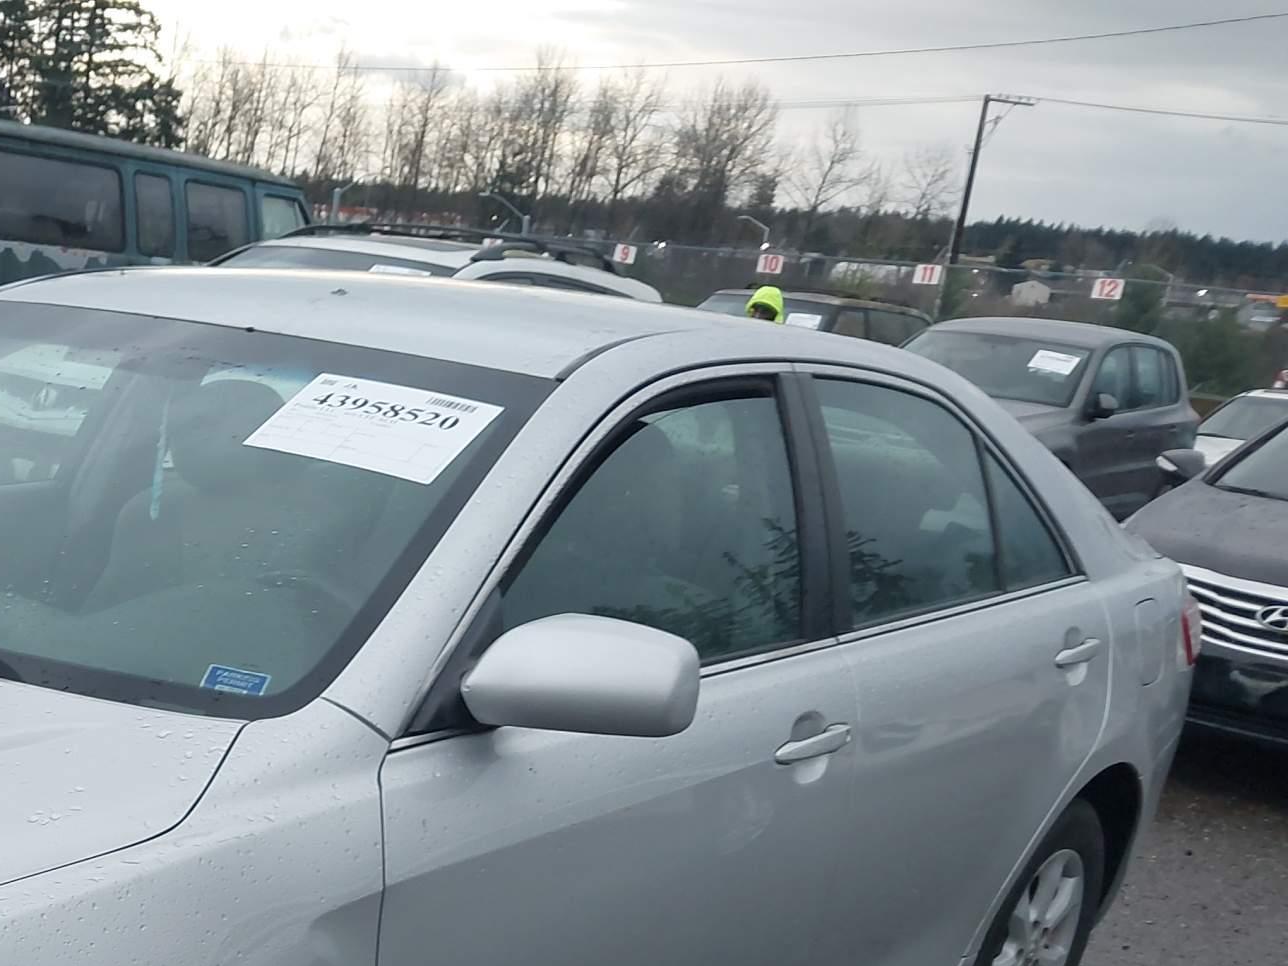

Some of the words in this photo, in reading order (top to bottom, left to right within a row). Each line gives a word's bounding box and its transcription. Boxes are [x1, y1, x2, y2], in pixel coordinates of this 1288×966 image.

[620, 246, 630, 261] 9
[763, 255, 780, 272] 10
[920, 264, 936, 282] 11
[1098, 279, 1120, 297] 12
[312, 392, 460, 431] 43958520
